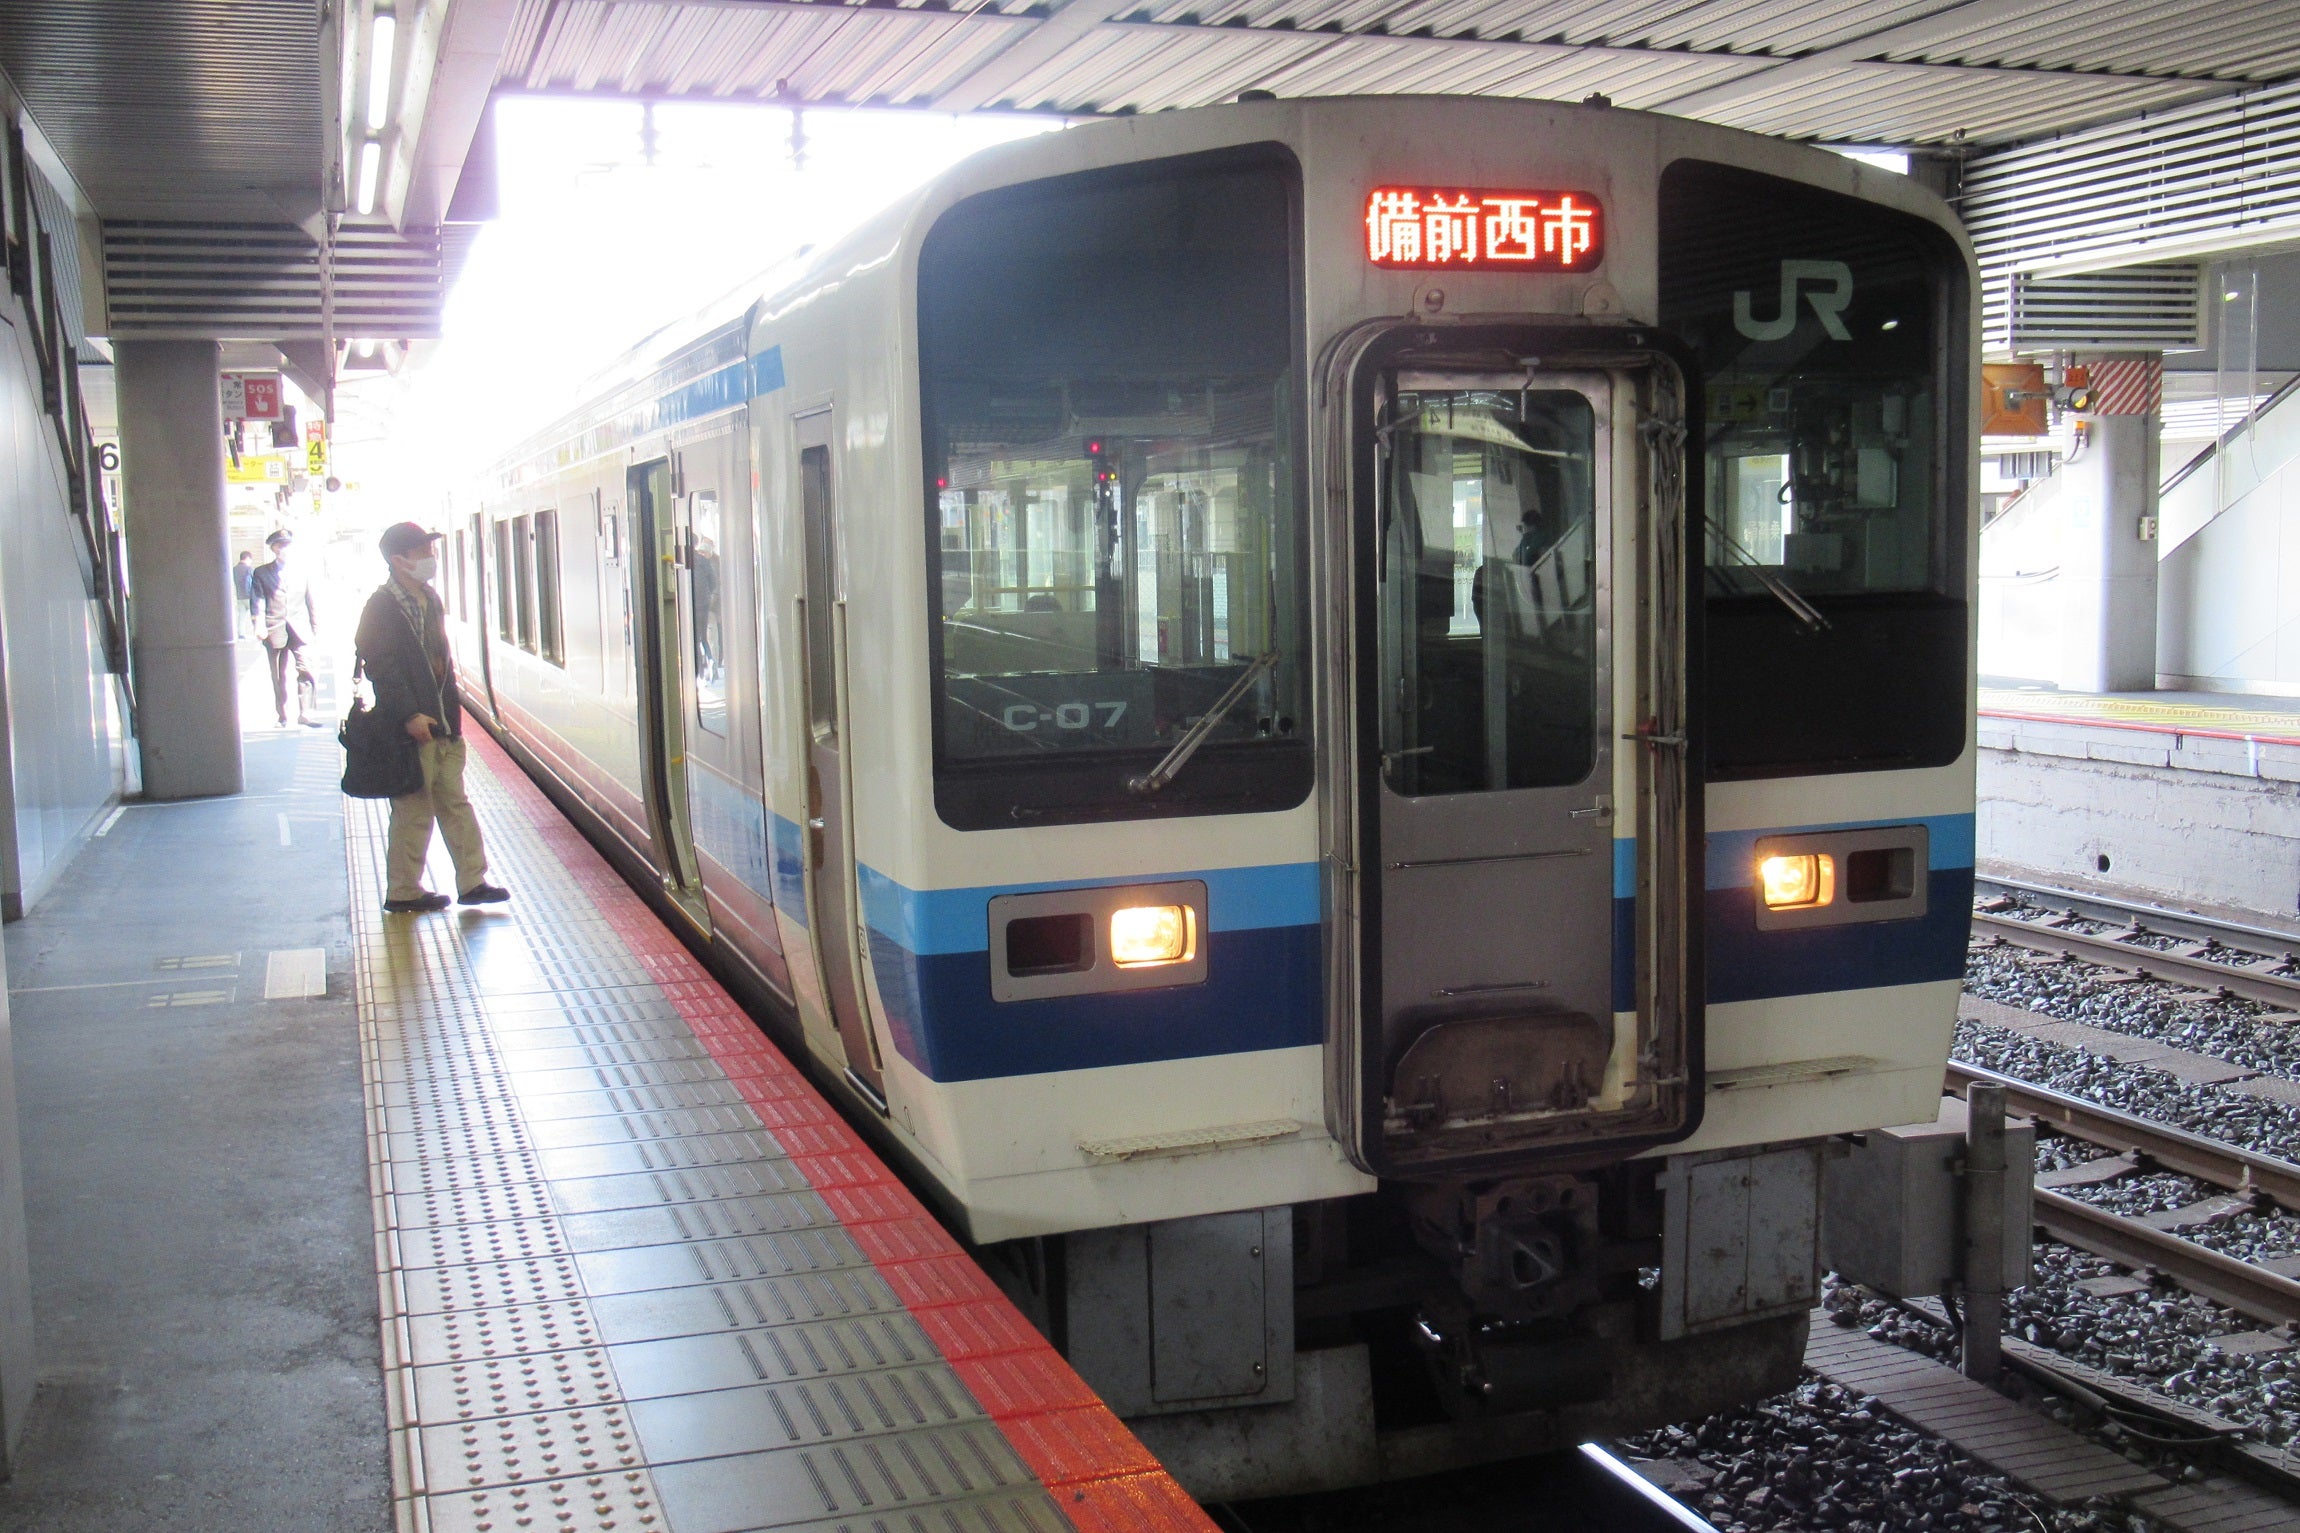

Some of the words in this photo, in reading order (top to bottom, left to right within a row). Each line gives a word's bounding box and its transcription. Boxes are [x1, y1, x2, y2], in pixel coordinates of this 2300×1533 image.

[1366, 192, 1594, 264] 備前西市
[1732, 259, 1854, 341] JR
[248, 384, 274, 394] SOS
[99, 442, 119, 471] 6
[309, 440, 325, 459] 4
[1003, 700, 1128, 732] C-07
